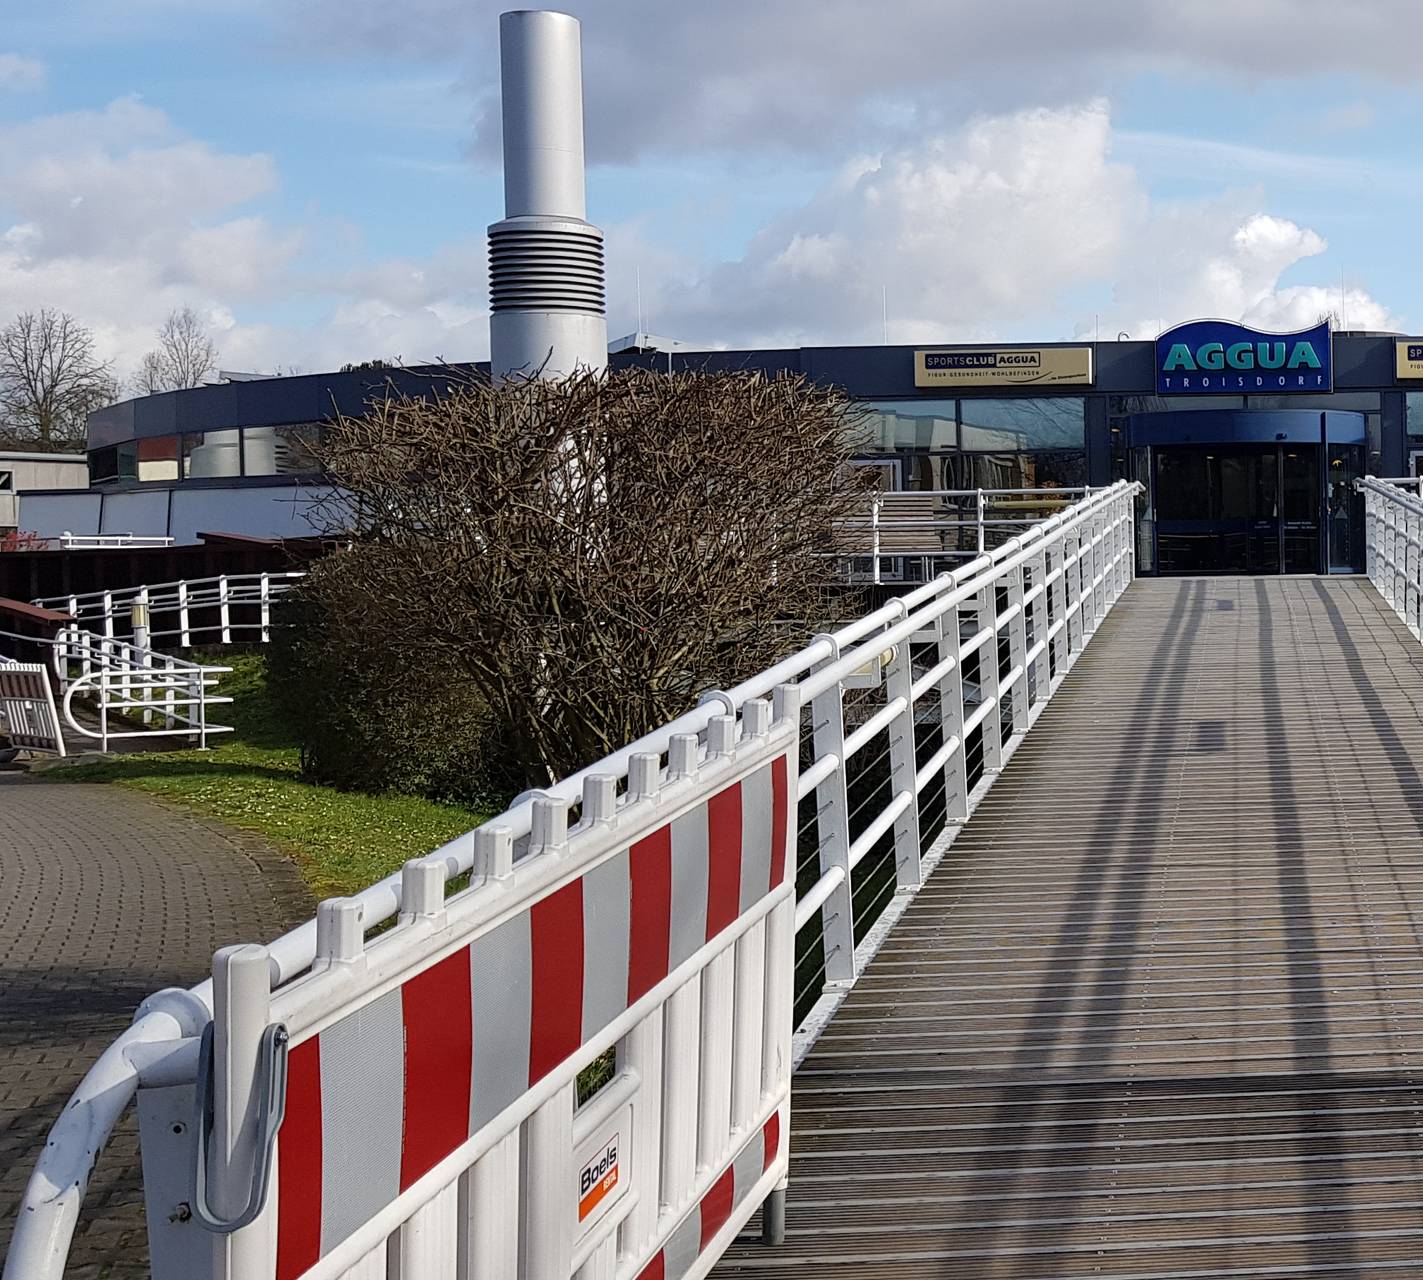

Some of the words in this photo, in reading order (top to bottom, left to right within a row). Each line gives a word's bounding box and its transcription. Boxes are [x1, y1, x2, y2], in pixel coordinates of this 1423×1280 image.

[927, 356, 995, 366] SPORTSCLUB
[999, 355, 1037, 364] AGGUA
[1162, 341, 1322, 371] AGGUA
[1165, 376, 1323, 388] TROISDORF
[581, 1147, 617, 1195] Boels
